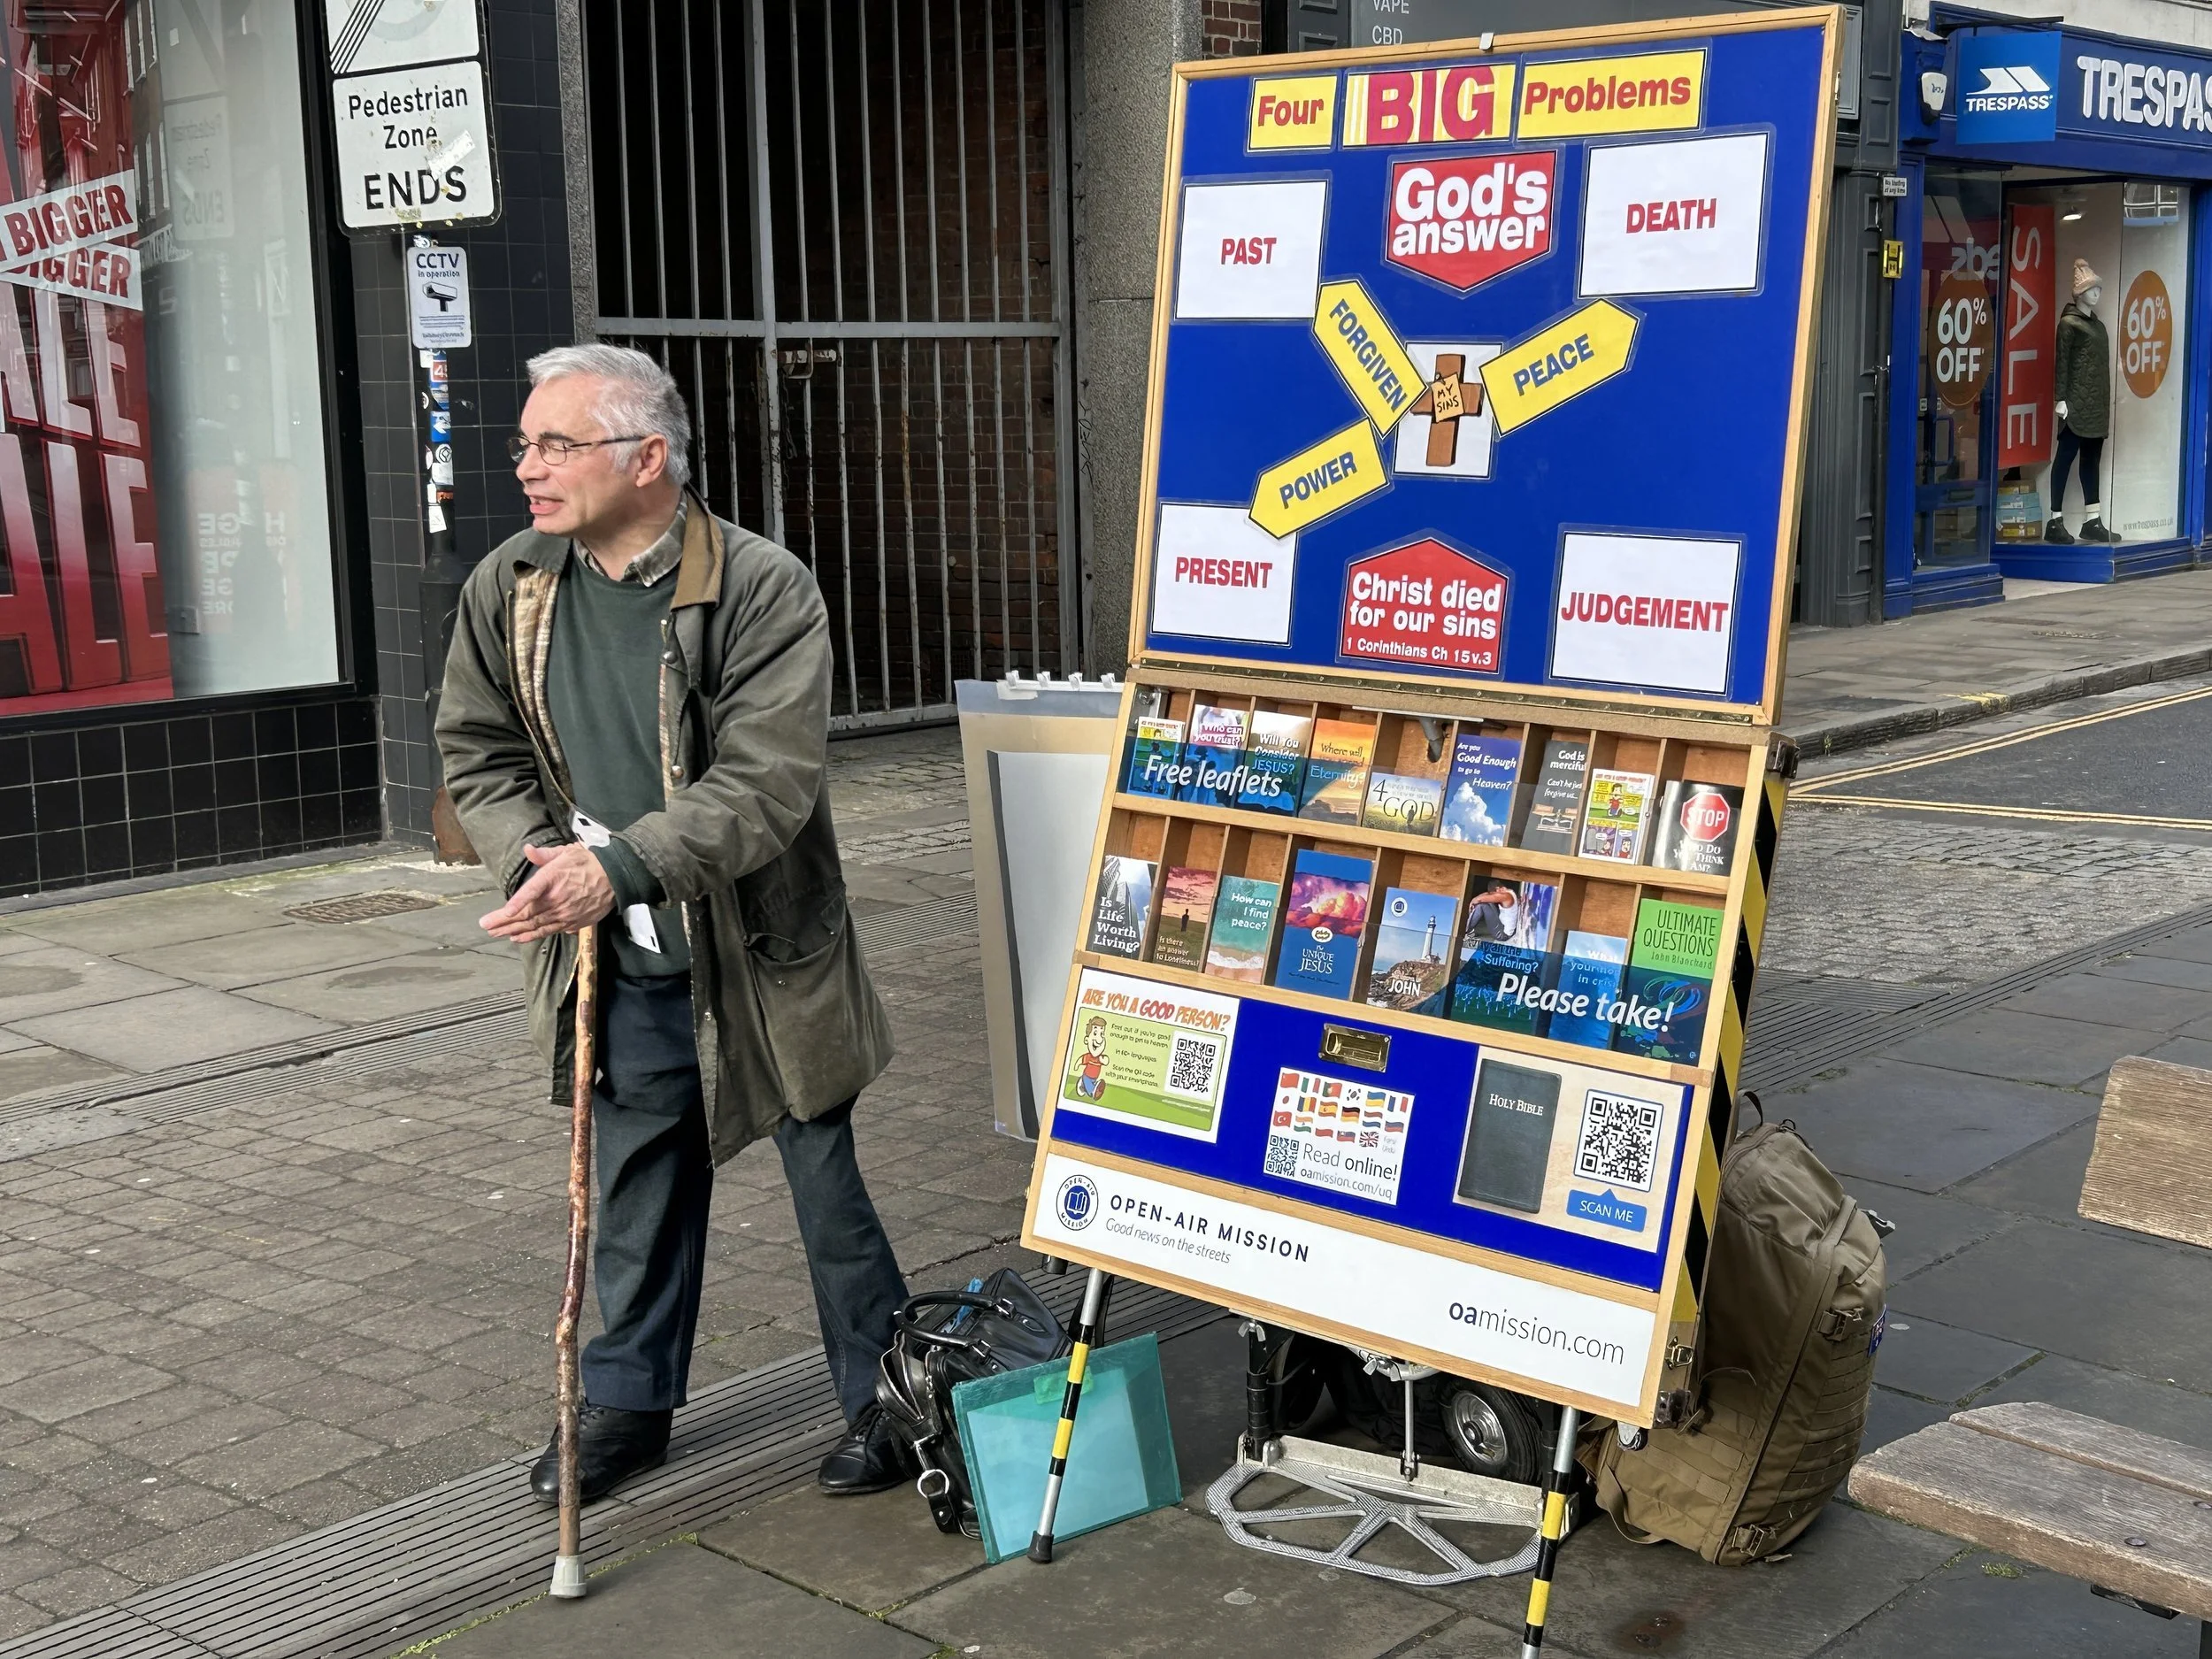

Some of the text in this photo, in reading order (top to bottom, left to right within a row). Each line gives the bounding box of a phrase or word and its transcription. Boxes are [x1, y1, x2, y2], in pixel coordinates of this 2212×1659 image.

[1372, 0, 1409, 15] VAPE
[1371, 26, 1402, 45] CBD
[349, 85, 468, 119] Pedestrian
[1258, 66, 1691, 145] Four BIG Problems
[1966, 95, 2051, 112] TRESPASS
[384, 124, 438, 150] Zone
[365, 166, 467, 210] ENDS
[1394, 163, 1548, 222] God's
[4, 184, 133, 257] BIGGER
[1626, 198, 1717, 234] DEATH
[1393, 213, 1545, 257] answer
[416, 253, 459, 268] CCTV
[1221, 237, 1277, 265] PAST
[426, 270, 460, 279] operation
[1937, 297, 1986, 345] 60%
[2127, 296, 2166, 340] 60%
[2007, 226, 2040, 449] SALE
[1329, 298, 1409, 413] FORGIVEN
[1513, 334, 1594, 396] PEACE
[1436, 396, 1460, 412] SINS
[1438, 387, 1452, 399] MY
[1279, 451, 1357, 510] POWER
[1175, 557, 1273, 588] PRESENT
[1353, 572, 1502, 611] Christ died
[1350, 601, 1496, 640] for our sins
[1561, 592, 1729, 633] JUDGEMENT
[1347, 637, 1353, 650] 1
[1357, 638, 1428, 658] Corinthians
[1432, 646, 1448, 661] Ch
[1212, 735, 1240, 746] trust?
[1260, 733, 1299, 748] Will You
[1321, 743, 1363, 757] Where will
[1255, 746, 1299, 760] Consider
[1457, 752, 1517, 770] Good Enough
[1559, 750, 1585, 761] God is
[1144, 755, 1282, 796] Free leaflets
[1252, 760, 1294, 774] JESUS?
[1310, 764, 1366, 788] Eternity?
[1373, 780, 1388, 801] 4
[1472, 778, 1512, 790] Heaven?
[1383, 797, 1434, 821] GOD
[1687, 807, 1725, 826] STOP
[1696, 853, 1724, 864] THINK
[1706, 844, 1721, 854] DO
[1101, 897, 1112, 908] Is
[1232, 893, 1272, 908] How can
[1098, 910, 1124, 922] Life
[1244, 907, 1269, 918] I find
[1657, 910, 1717, 936] ULTIMATE
[1097, 922, 1136, 938] Worth
[1232, 918, 1266, 931] peace?
[1094, 934, 1140, 953] Living?
[1643, 929, 1715, 957] QUESTIONS
[1298, 958, 1333, 974] JESUS
[1302, 949, 1334, 963] UNIQUE
[1485, 954, 1539, 973] Suffering?
[1571, 962, 1596, 972] your
[1651, 951, 1713, 970] John Blanchard
[1388, 979, 1421, 996] JOHN
[1578, 974, 1588, 984] in
[1081, 988, 1231, 1032] ARE YOU A GOOD PERSON?
[1496, 972, 1675, 1033] Please take!
[1489, 1093, 1544, 1117] HOLY BIBLE
[1302, 1143, 1398, 1182] Read online!
[1301, 1168, 1393, 1201] oamission.com/uq
[1579, 1200, 1633, 1223] SCAN ME
[1110, 1194, 1309, 1262] OPEN-AIR MISSION
[1106, 1217, 1232, 1263] Good news on the streets
[1448, 1302, 1624, 1365] oamission.com
